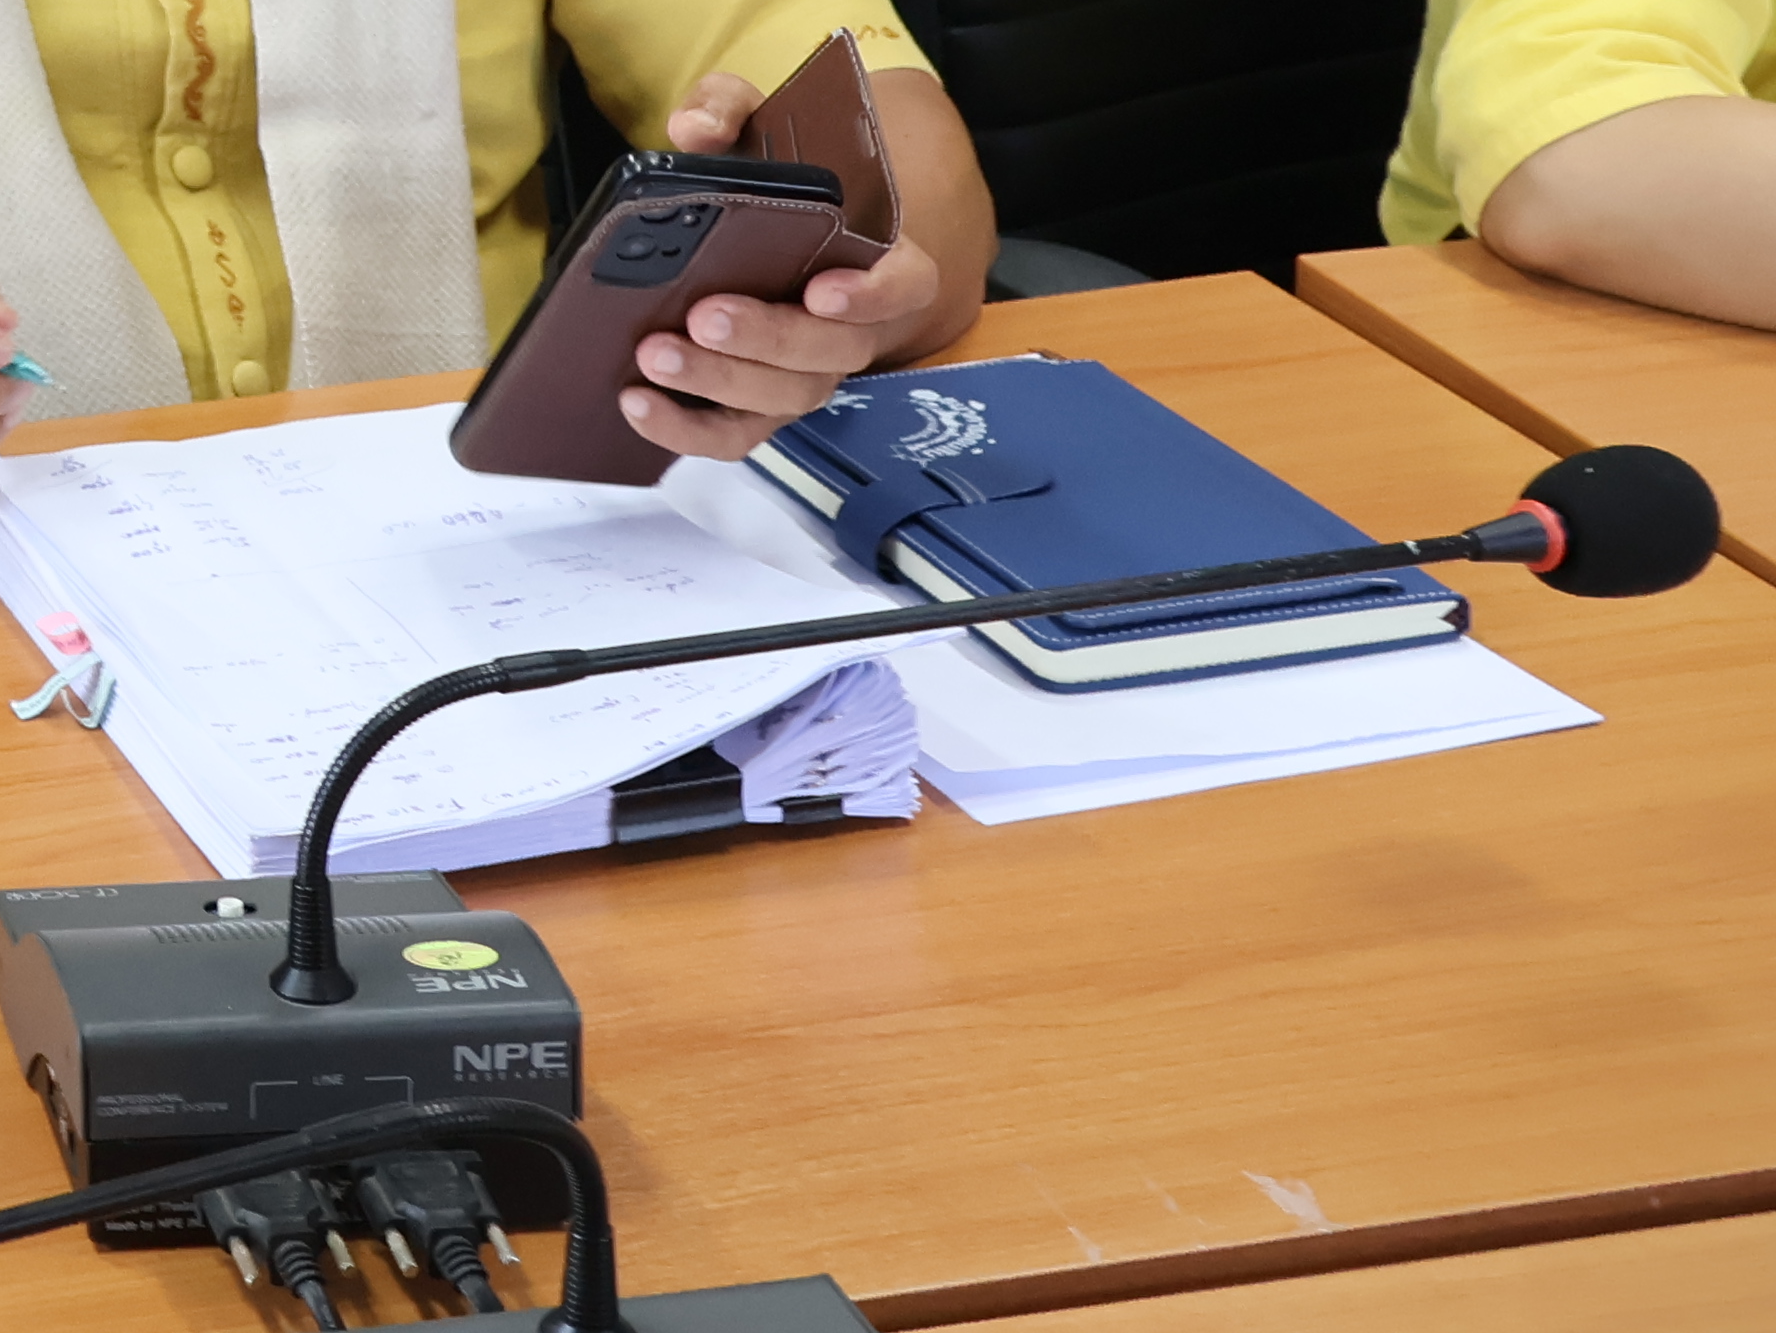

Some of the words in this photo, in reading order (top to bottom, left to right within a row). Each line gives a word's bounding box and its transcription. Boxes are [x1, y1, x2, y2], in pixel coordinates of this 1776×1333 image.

[411, 972, 529, 994] NPE
[453, 1041, 568, 1072] NPE
[312, 1074, 345, 1087] LINE
